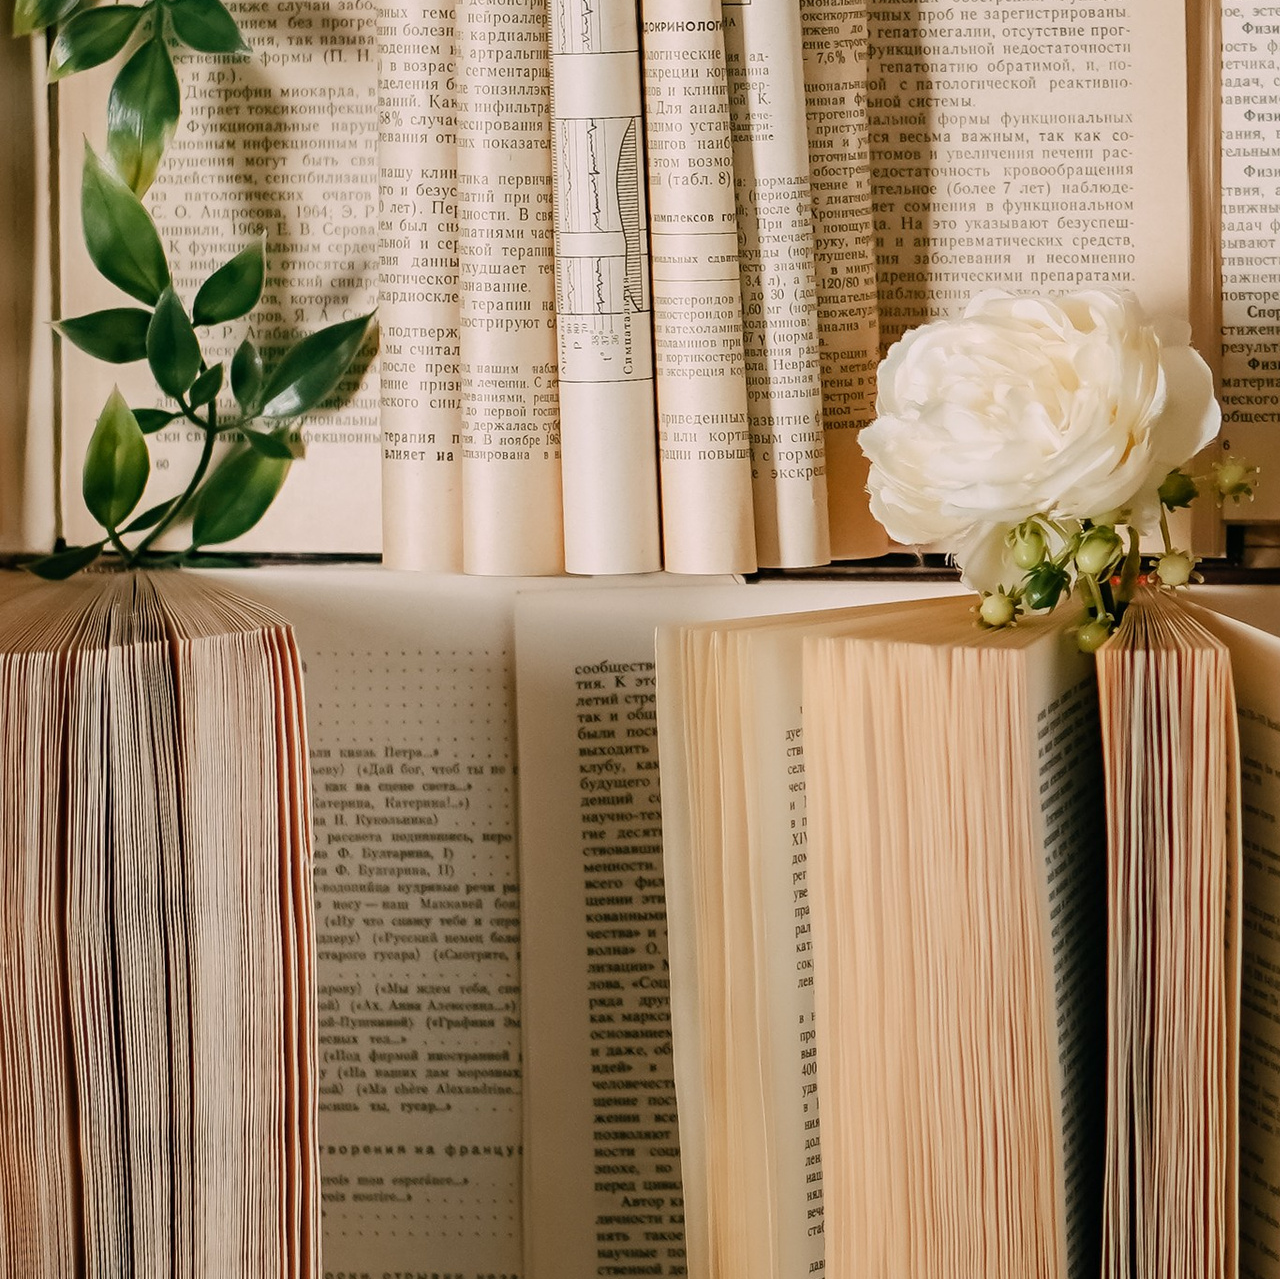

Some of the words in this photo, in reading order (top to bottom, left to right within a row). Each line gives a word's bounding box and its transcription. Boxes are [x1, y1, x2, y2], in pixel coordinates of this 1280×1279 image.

[1002, 27, 1085, 41] отсутствие
[1091, 26, 1130, 40] прог-
[899, 132, 951, 143] весьма
[961, 132, 1029, 144] важным,
[1039, 132, 1064, 142] так
[1074, 132, 1101, 142] как
[1112, 131, 1134, 141] со-
[668, 171, 705, 188] (табл.
[710, 171, 731, 188] 8)
[947, 182, 996, 197] (более
[1003, 181, 1011, 194] 7
[1019, 181, 1051, 197] лет)
[1062, 181, 1134, 194] наблюде-
[901, 216, 923, 230] На
[933, 220, 957, 230] это
[965, 219, 1049, 233] указывают
[1057, 216, 1134, 232] безуспеш-
[575, 680, 605, 690] тия.
[615, 675, 626, 688] К
[577, 727, 616, 740] были
